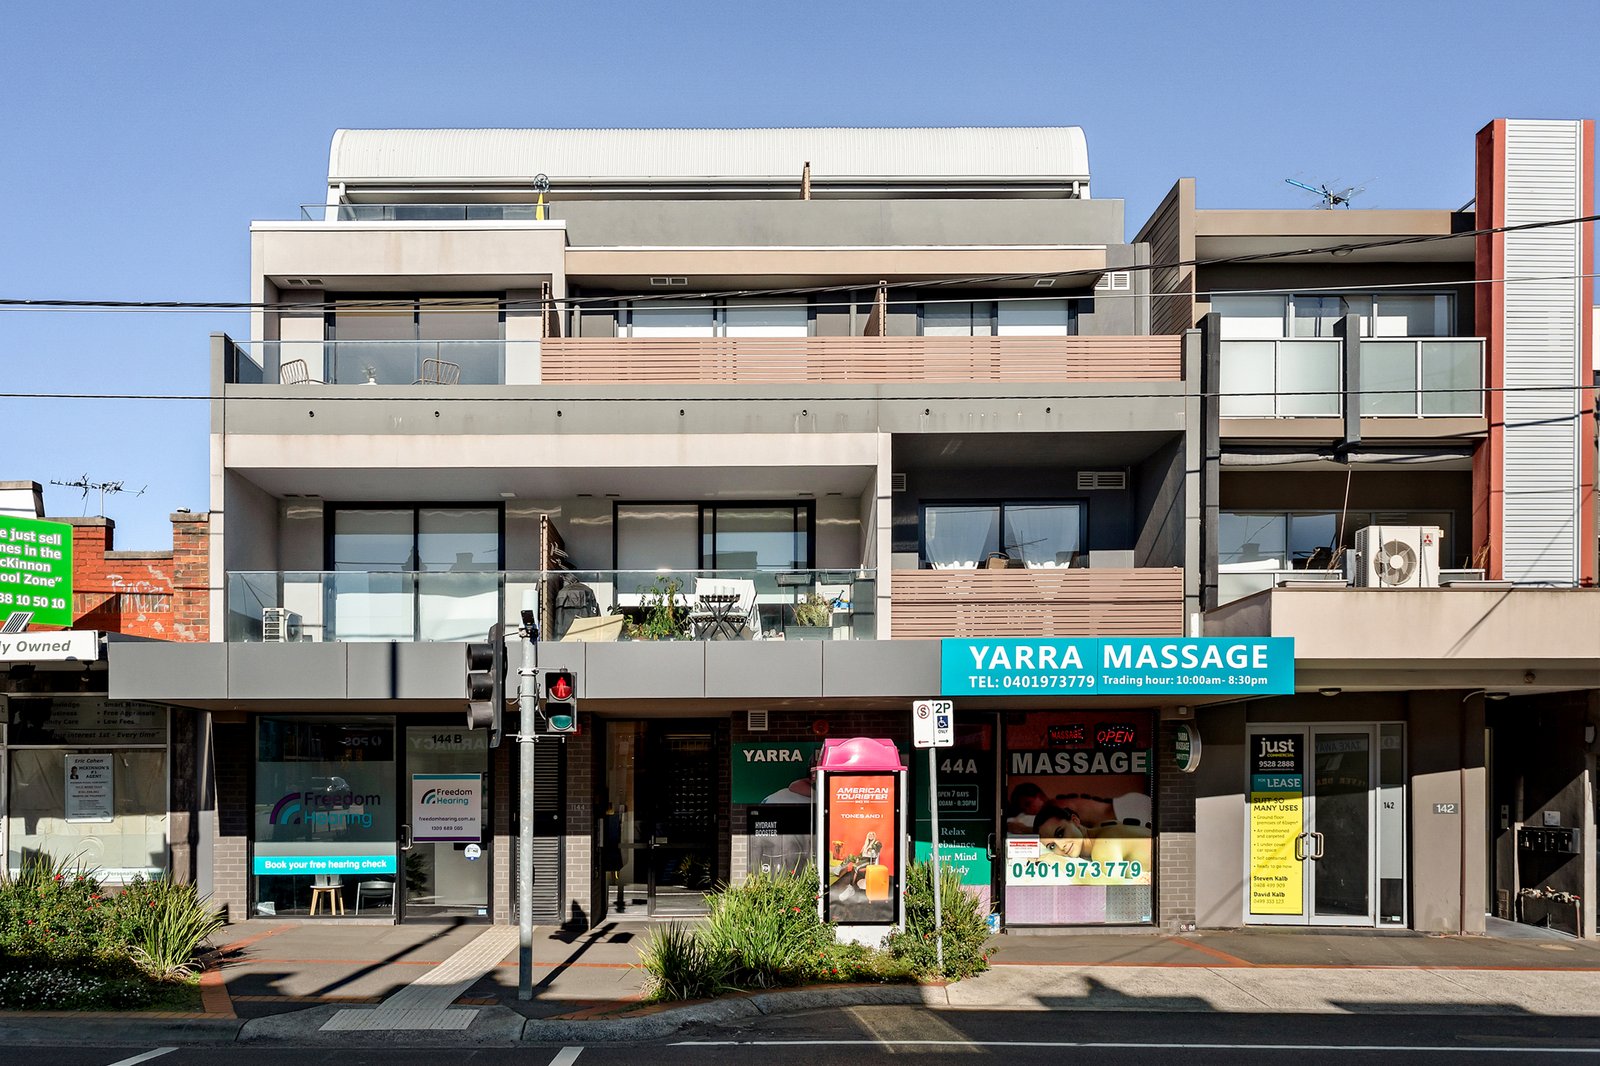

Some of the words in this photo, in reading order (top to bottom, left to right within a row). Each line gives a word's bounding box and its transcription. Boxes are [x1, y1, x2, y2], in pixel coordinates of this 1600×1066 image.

[10, 528, 36, 542] just
[39, 534, 61, 545] sell
[25, 545, 37, 556] in
[40, 547, 61, 559] the
[16, 595, 30, 606] 10
[33, 597, 48, 607] 50
[51, 598, 65, 609] 10
[16, 640, 71, 652] Owned
[969, 646, 1084, 670] YARRA
[1103, 644, 1268, 669] MASSAGE
[969, 676, 999, 688] TEL:
[1003, 675, 1095, 688] 0401973779
[1103, 675, 1143, 687] Trading
[1145, 675, 1174, 685] hour:
[1228, 676, 1268, 687] 8:30pm
[935, 703, 951, 714] 2P
[431, 734, 452, 744] 144
[454, 734, 462, 744] B
[1097, 730, 1135, 744] OPEN
[1258, 737, 1295, 758] just
[742, 749, 803, 762] YARRA
[1012, 752, 1147, 774] MASSAGE
[1258, 760, 1276, 768] 9528
[1277, 760, 1295, 768] 2888
[1266, 778, 1301, 788] LEASE
[304, 791, 381, 806] Freedom
[437, 798, 469, 806] Hearing
[1383, 801, 1395, 809] 142
[1436, 804, 1454, 813] 142
[304, 810, 372, 828] Hearing
[754, 821, 777, 829] HYDRANT
[754, 829, 778, 837] BOOSTER
[941, 827, 965, 836] Relax
[954, 852, 977, 861] Mind
[265, 860, 287, 869] Book
[289, 861, 308, 871] your
[309, 860, 327, 869] free
[328, 860, 360, 871] hearing
[361, 859, 387, 868] check
